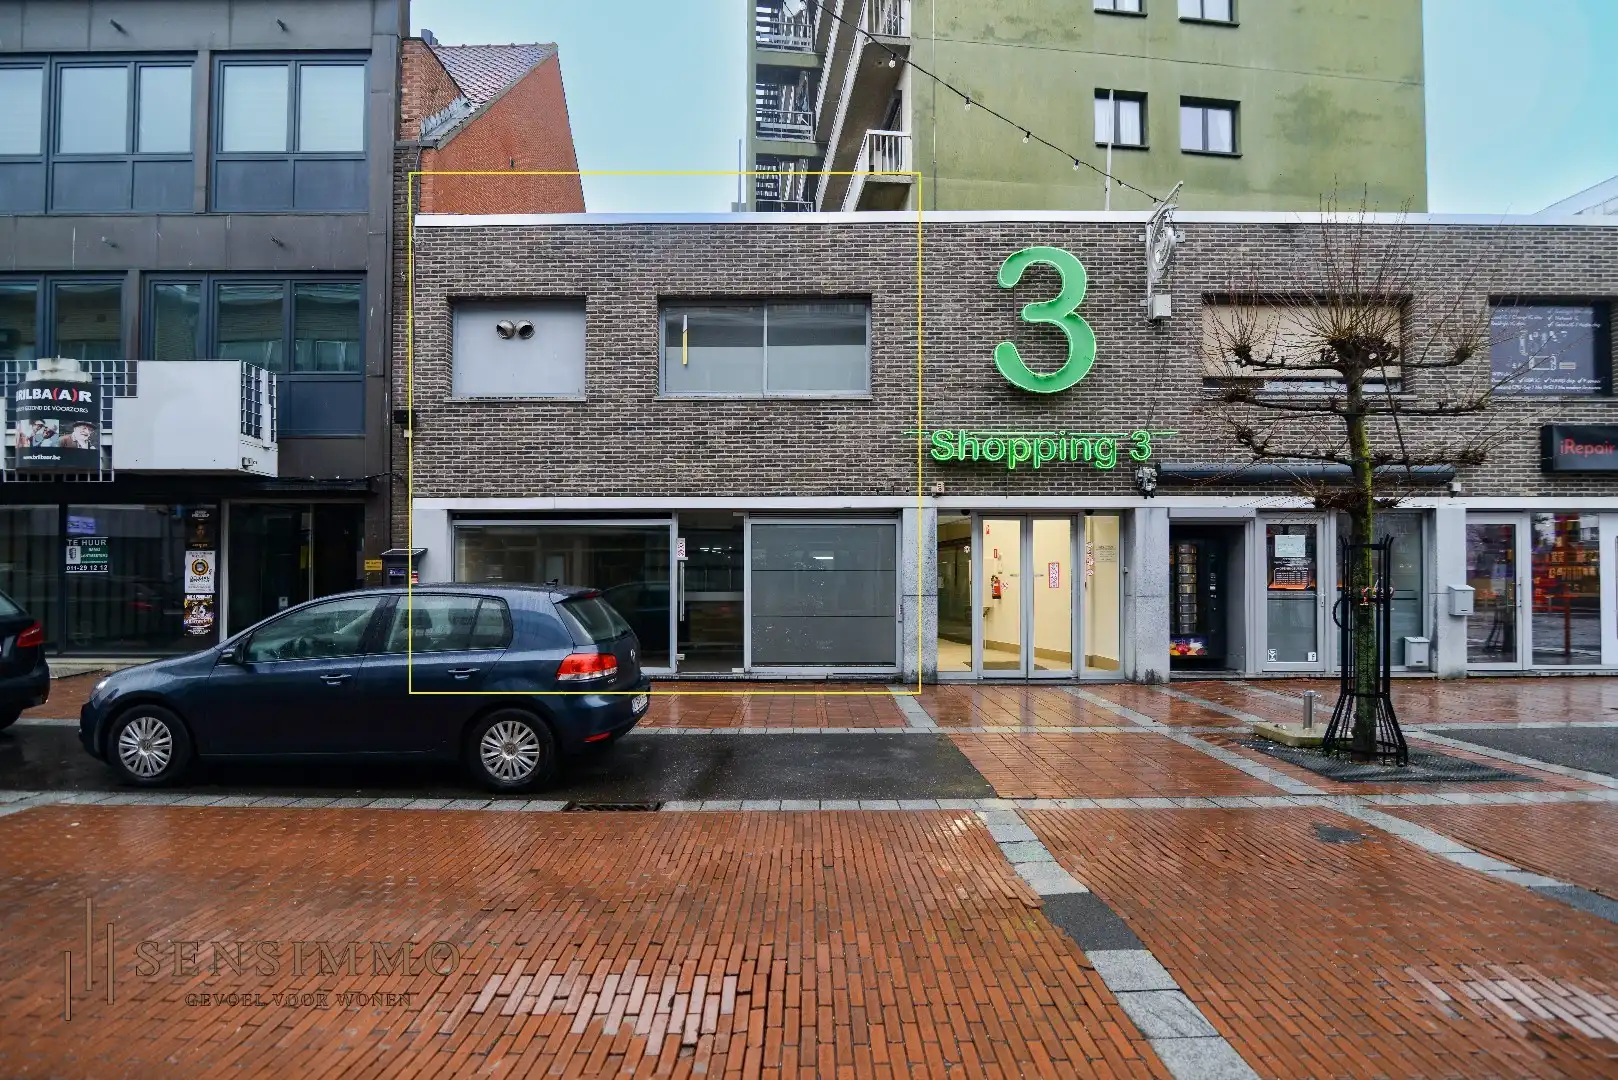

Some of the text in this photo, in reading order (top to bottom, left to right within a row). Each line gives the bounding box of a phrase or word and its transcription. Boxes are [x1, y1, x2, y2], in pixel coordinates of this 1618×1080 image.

[994, 246, 1096, 393] 3
[931, 429, 1151, 470] Shopping 3
[1560, 438, 1615, 458] iRepair
